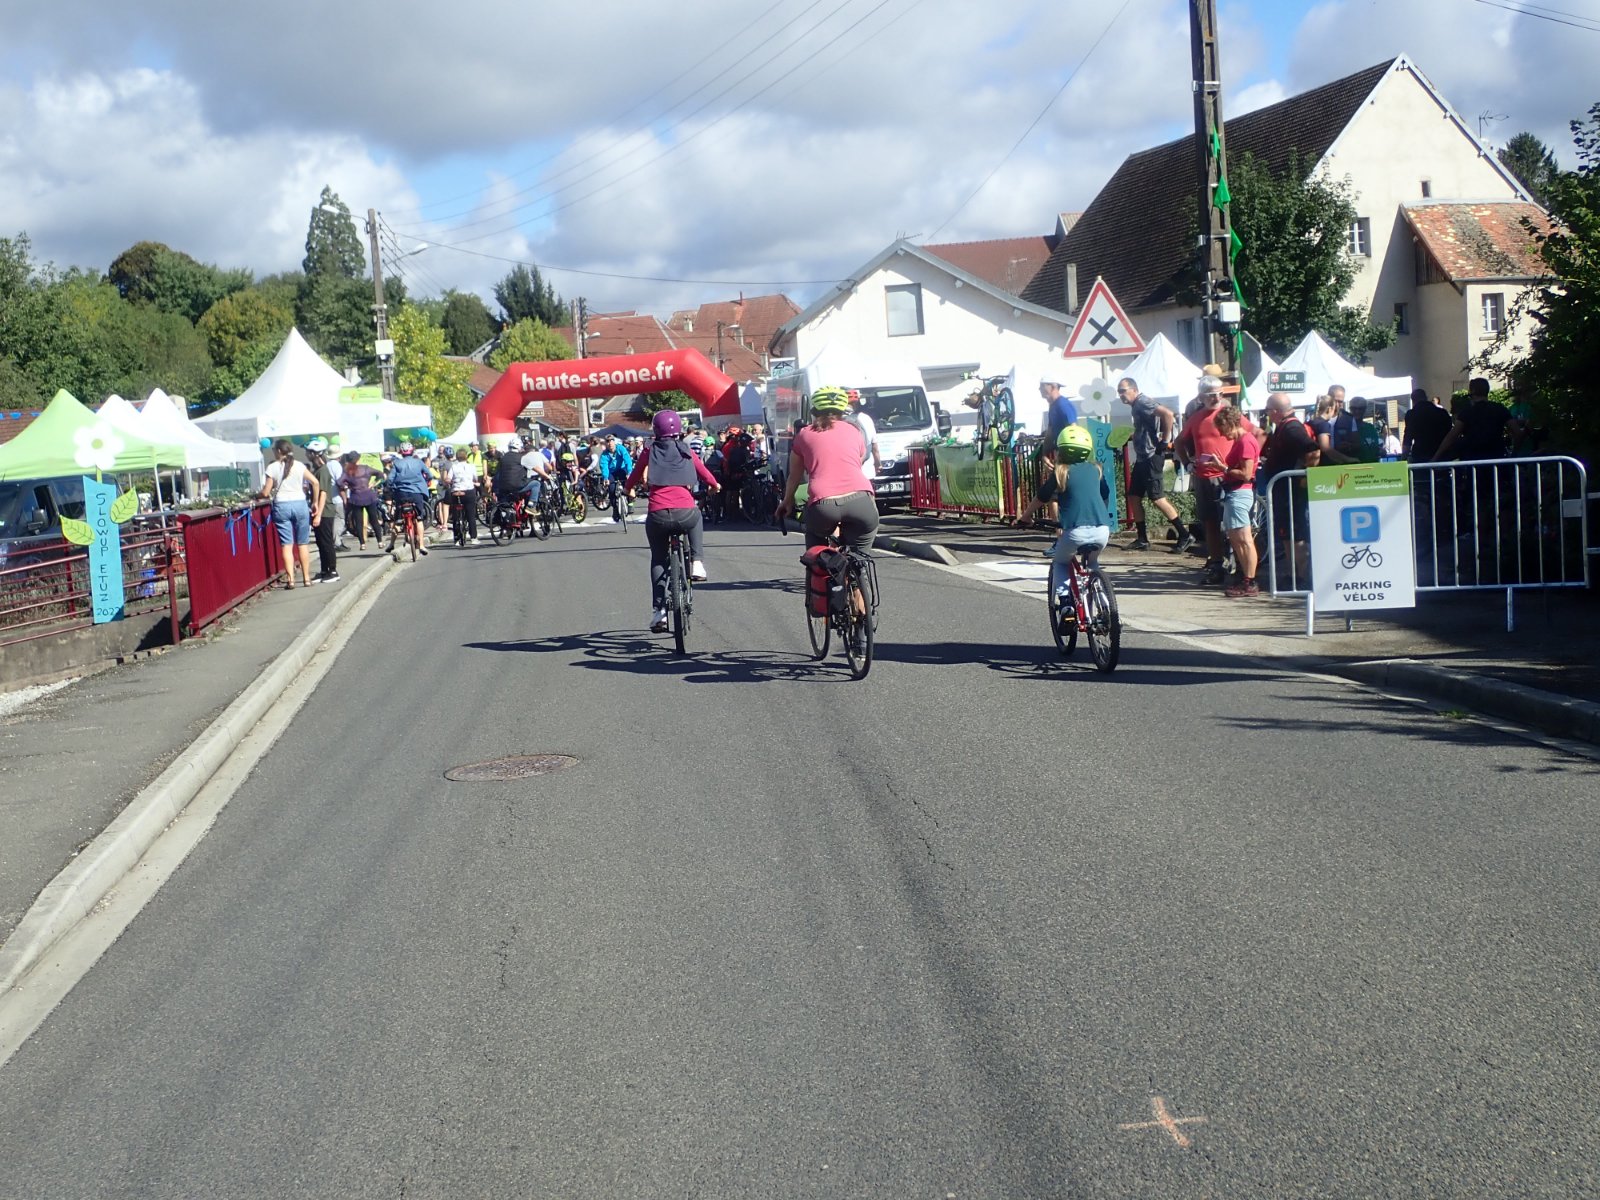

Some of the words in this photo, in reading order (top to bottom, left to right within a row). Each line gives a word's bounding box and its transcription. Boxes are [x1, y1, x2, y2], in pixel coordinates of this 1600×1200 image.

[521, 360, 674, 392] haute-saone.fr
[95, 493, 109, 557] SLOWUP
[1350, 511, 1373, 539] P
[98, 564, 109, 602] ETUZ
[1335, 580, 1392, 591] PARKING
[1343, 591, 1385, 602] VÉLOS
